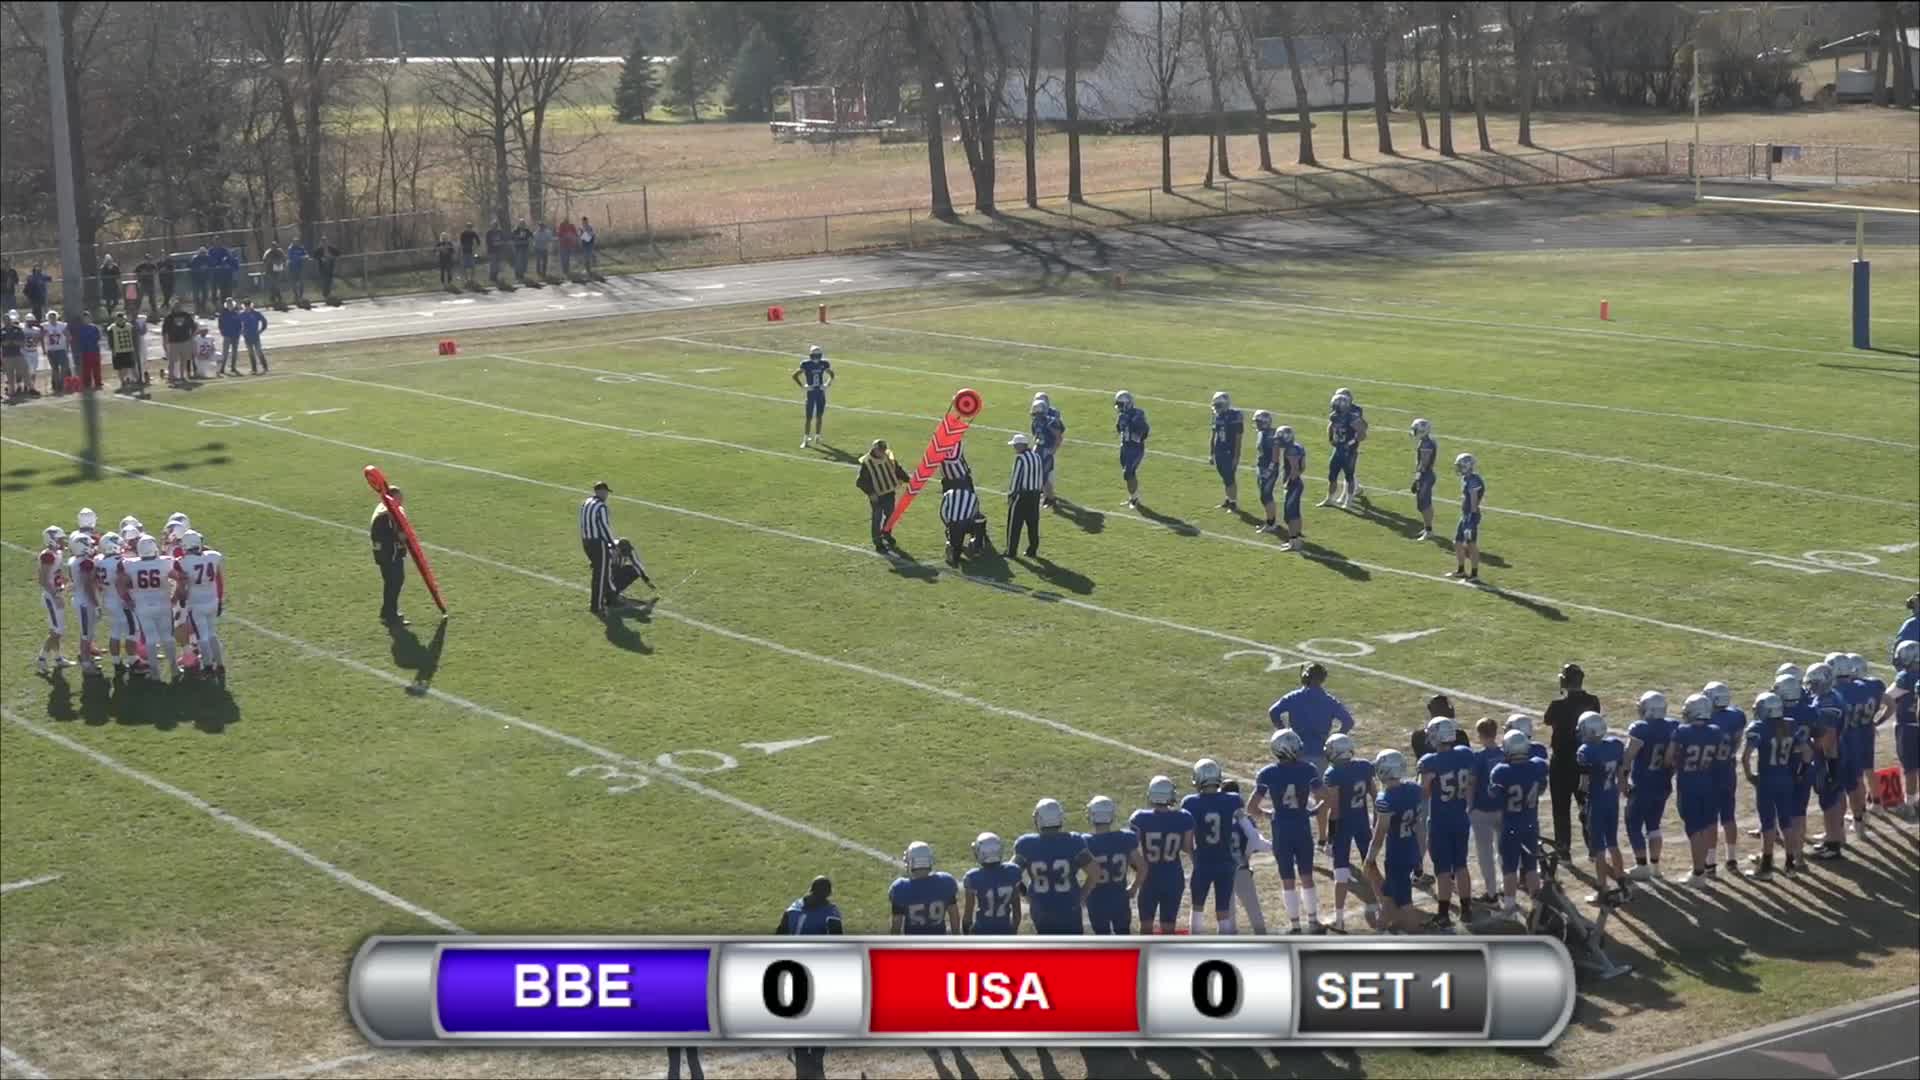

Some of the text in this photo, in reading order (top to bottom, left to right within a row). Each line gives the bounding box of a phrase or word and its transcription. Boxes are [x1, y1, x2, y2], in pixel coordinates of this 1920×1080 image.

[137, 569, 161, 588] 66
[194, 562, 214, 585] 74
[1223, 637, 1376, 672] 20
[1768, 737, 1792, 766] 19
[566, 749, 739, 795] 30
[1283, 784, 1299, 809] 4
[1350, 782, 1368, 809] 2
[1507, 782, 1538, 813] 24
[1879, 772, 1902, 804] 20
[1204, 811, 1221, 845] 3
[1145, 831, 1182, 863] 50
[1031, 858, 1072, 894] 63
[908, 900, 946, 927] 59
[984, 885, 1015, 918] 17
